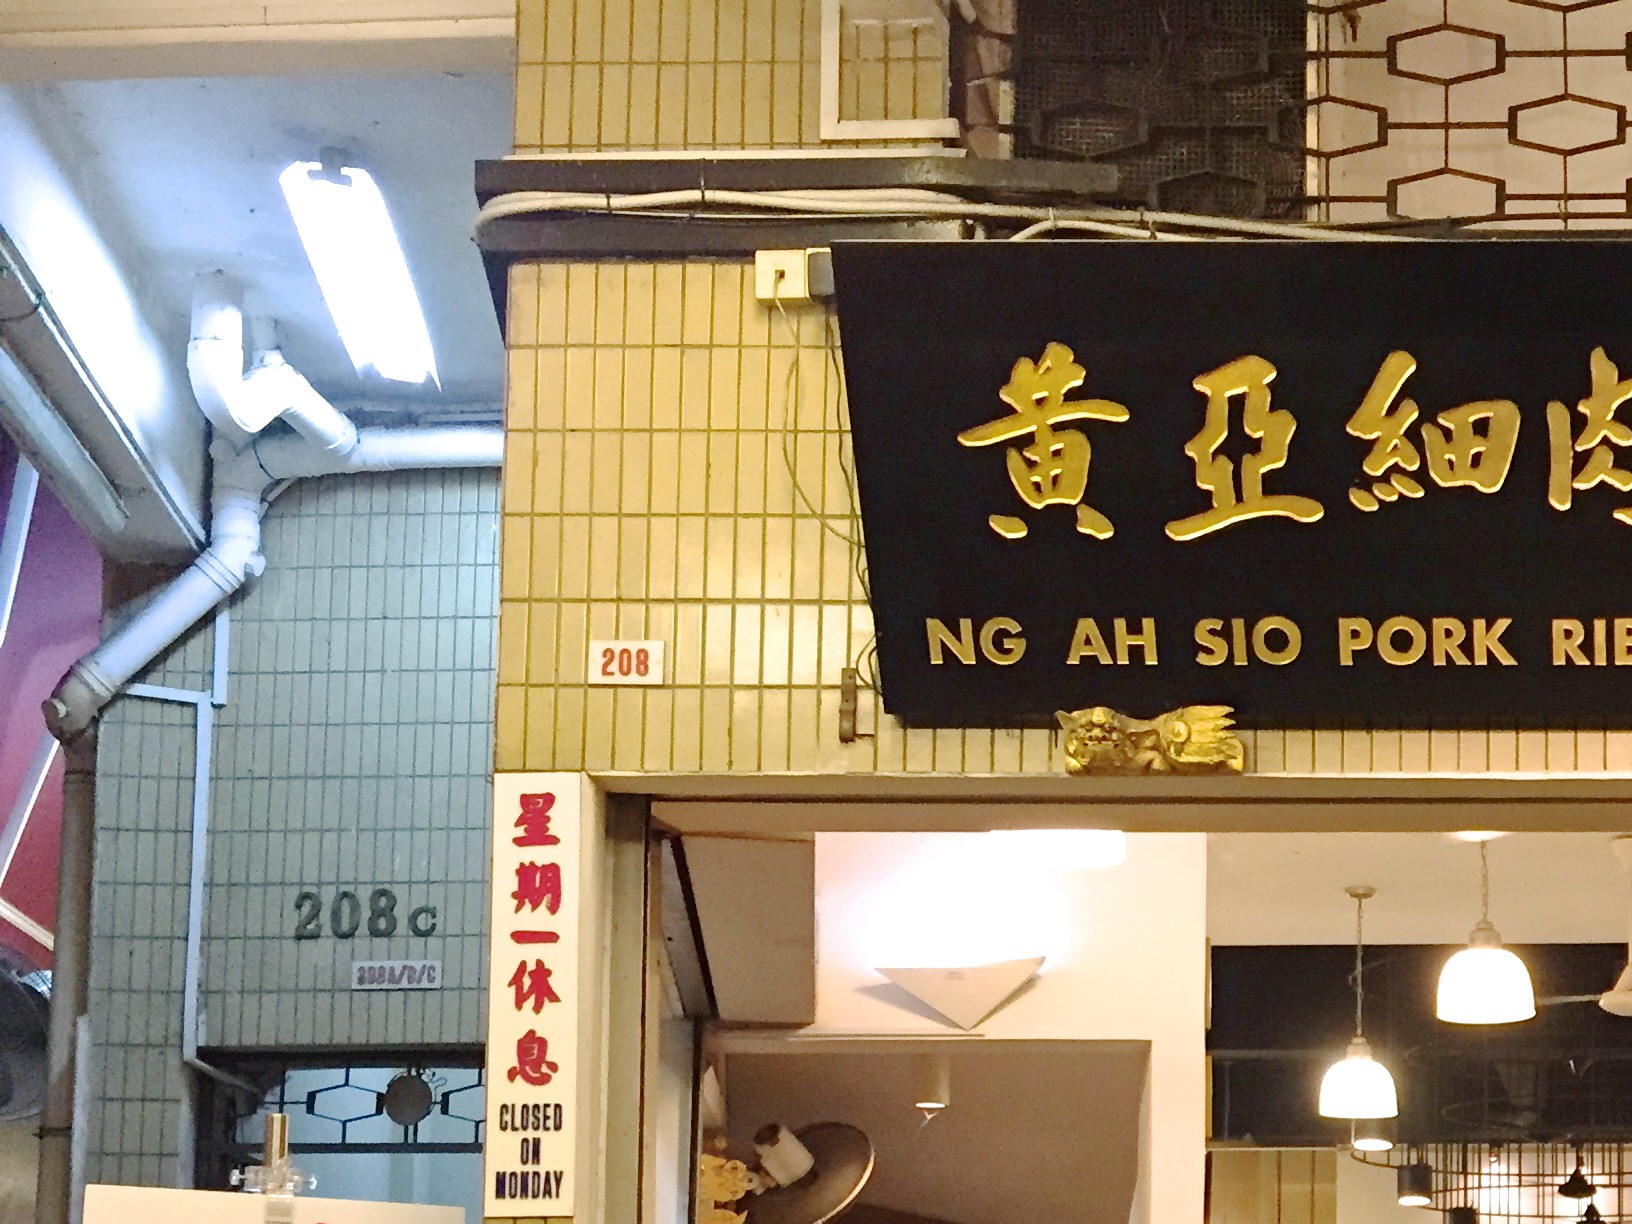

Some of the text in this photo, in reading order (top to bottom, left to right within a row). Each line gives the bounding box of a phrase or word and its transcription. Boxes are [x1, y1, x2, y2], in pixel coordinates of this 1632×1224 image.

[926, 617, 1027, 666] NG
[1066, 617, 1158, 666] AH
[1195, 616, 1302, 666] SIO
[1338, 616, 1519, 667] PORK
[602, 648, 649, 676] 208
[507, 791, 562, 1086] 星期一休息
[499, 1103, 562, 1132] CLOSED
[520, 1137, 541, 1166] ON
[495, 1170, 564, 1200] MONDAY
